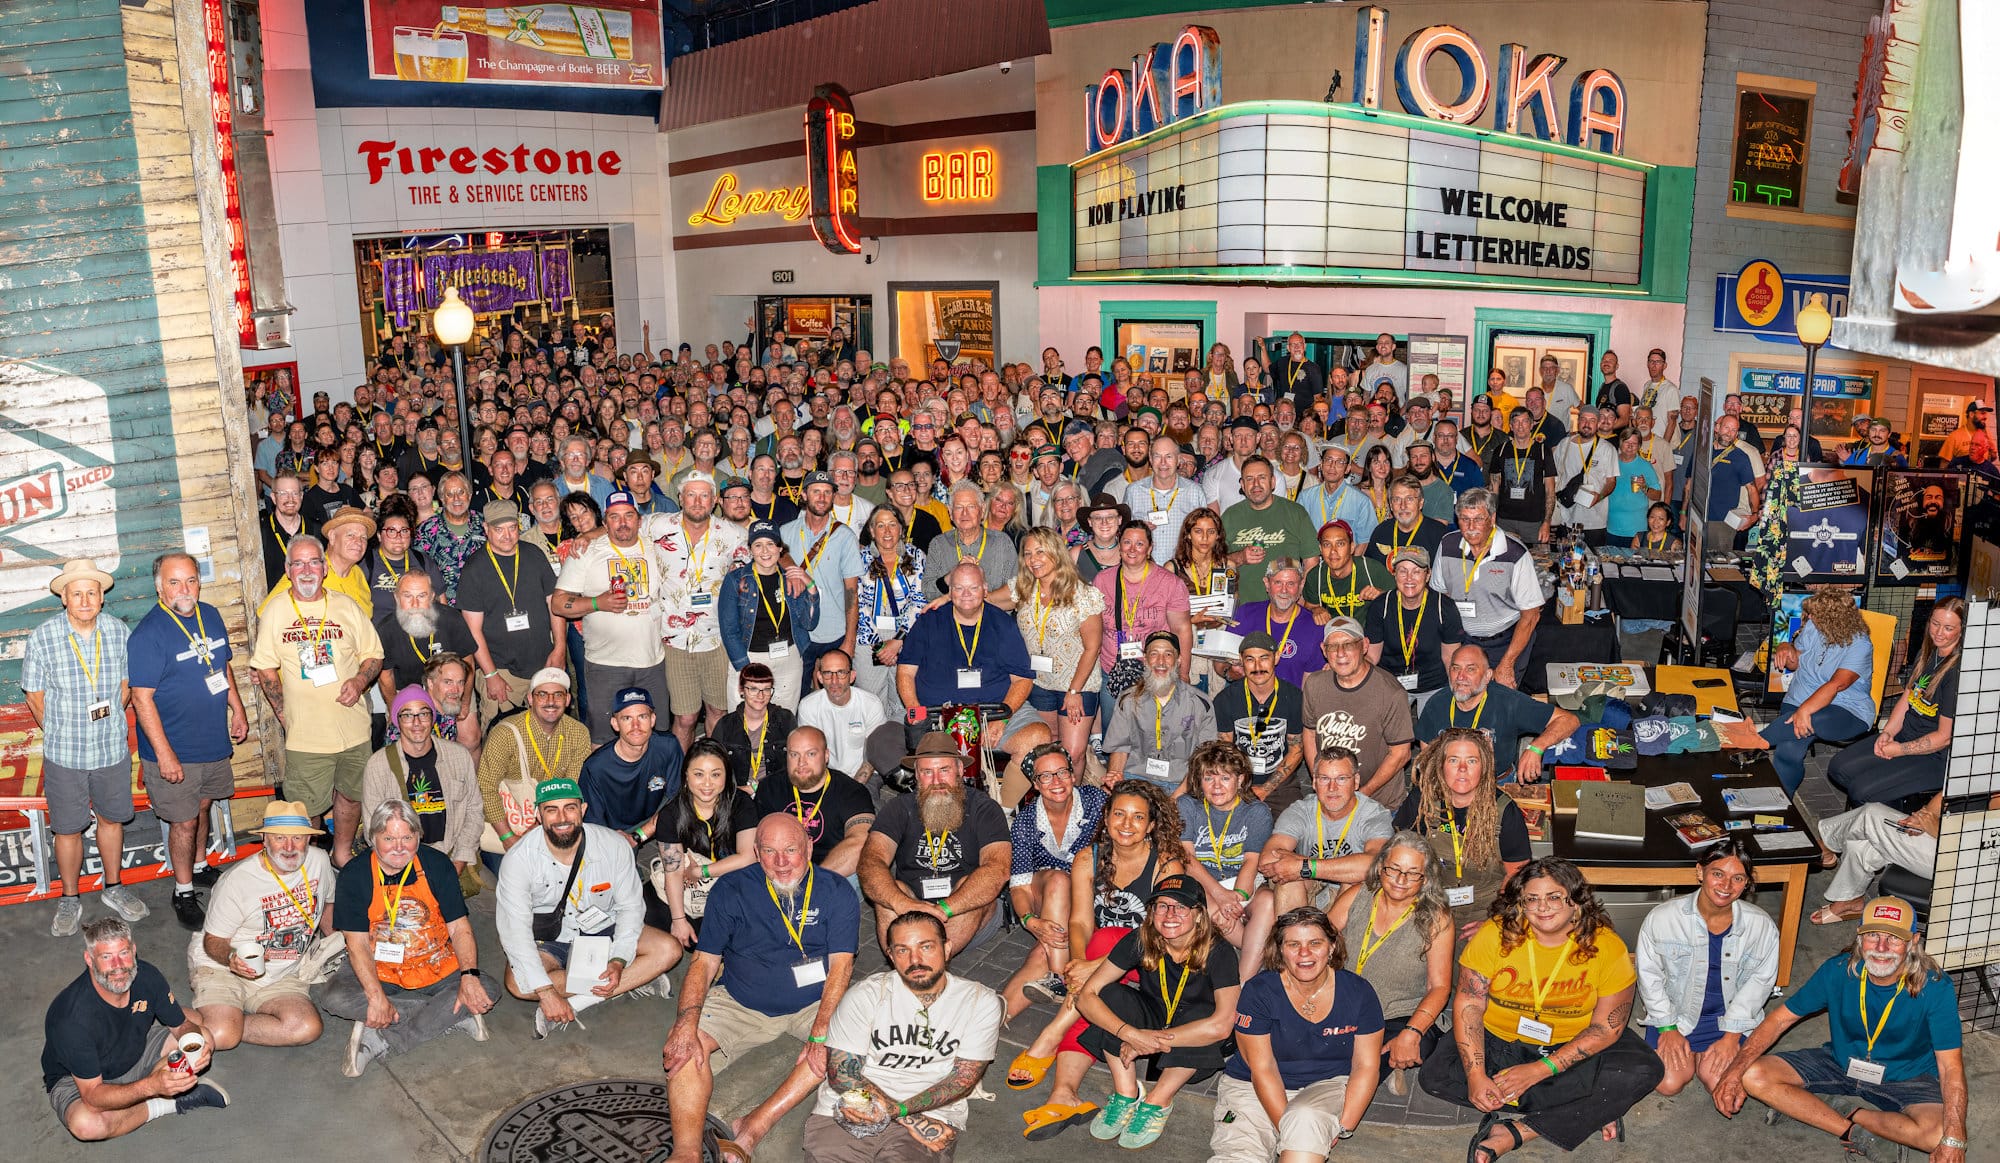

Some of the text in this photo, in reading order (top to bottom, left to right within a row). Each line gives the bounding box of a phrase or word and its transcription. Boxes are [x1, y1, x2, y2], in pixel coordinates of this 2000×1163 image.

[476, 58, 497, 70] The
[498, 59, 555, 74] Champagne
[557, 62, 567, 72] of
[569, 63, 594, 74] Bottle
[596, 63, 621, 75] BEER
[1353, 5, 1627, 155] IOKA
[1084, 25, 1221, 155] IOKA
[358, 140, 622, 185] Firestone
[840, 112, 858, 214] BAR
[922, 149, 993, 201] BAR
[408, 184, 588, 205] TIRE & SERVICE CENTERS
[688, 172, 811, 226] Lenny
[1088, 184, 1186, 227] NOW PLAYING
[1440, 187, 1568, 228] WELCOME
[1416, 230, 1591, 270] LETTERHEADS
[774, 271, 793, 282] 601
[800, 318, 824, 328] Coffee
[1740, 395, 1786, 409] SIGNS
[1757, 405, 1769, 414] &
[66, 466, 113, 493] SLICED
[871, 1024, 960, 1056] KANSAS
[878, 1052, 934, 1069] CITY
